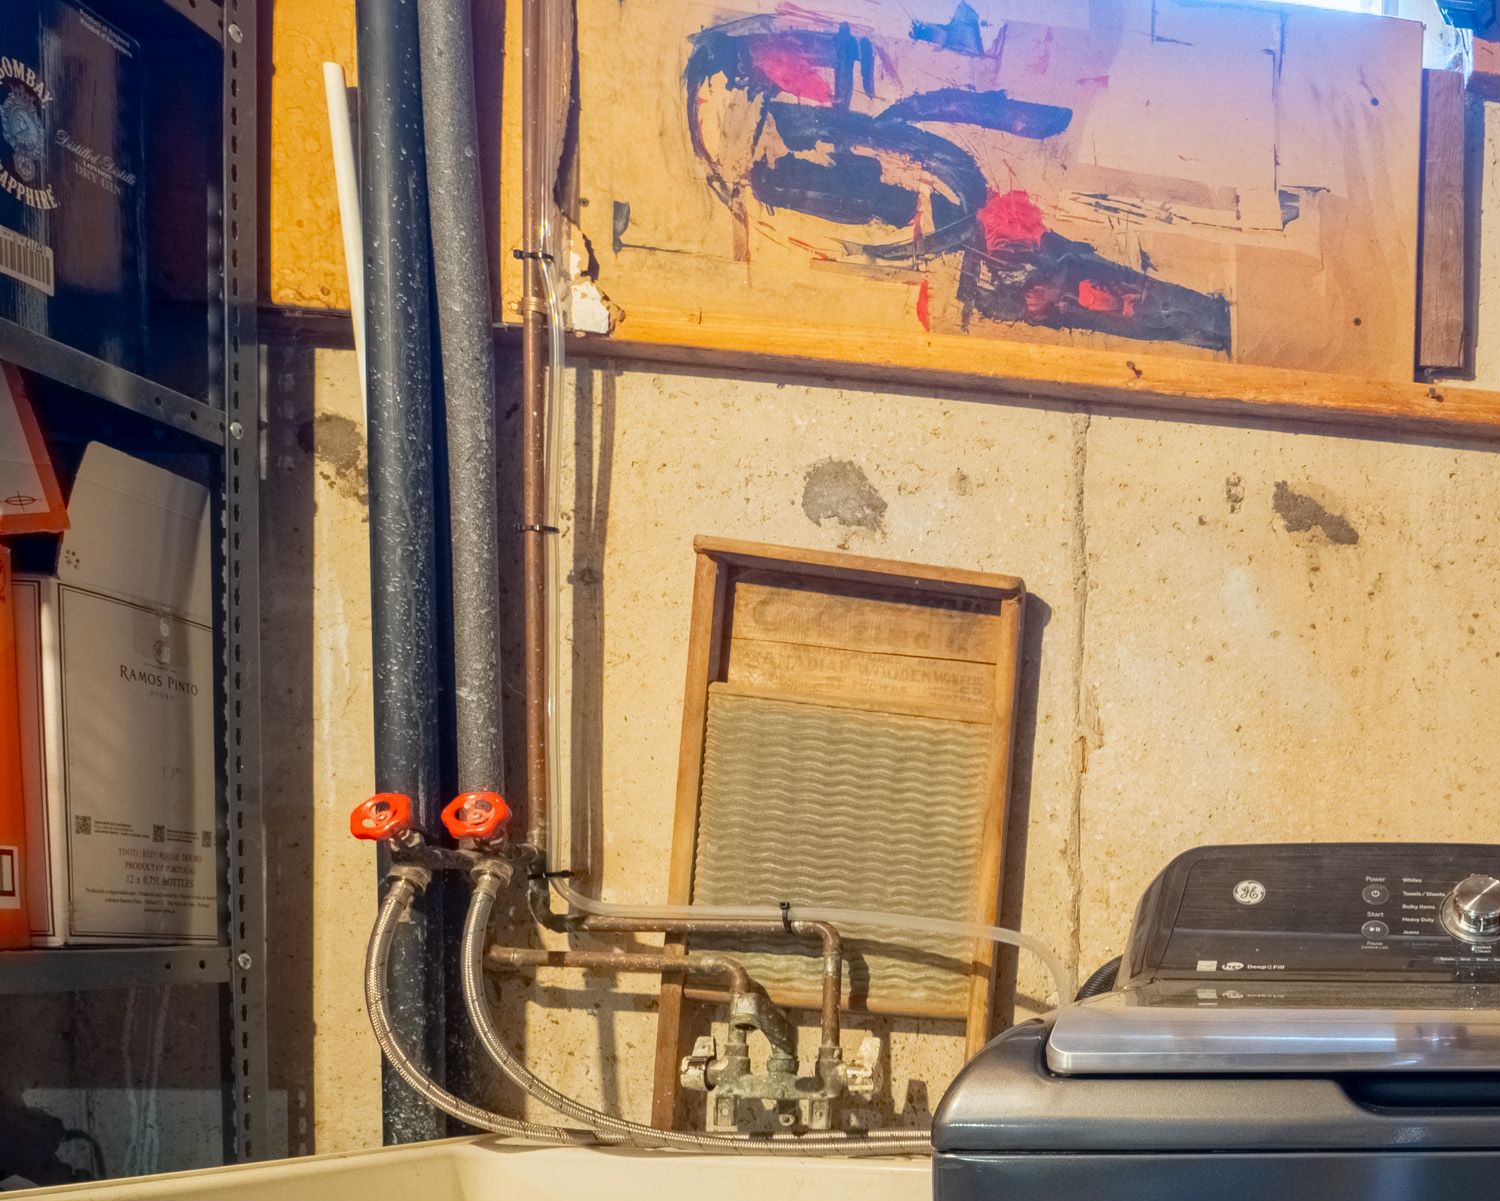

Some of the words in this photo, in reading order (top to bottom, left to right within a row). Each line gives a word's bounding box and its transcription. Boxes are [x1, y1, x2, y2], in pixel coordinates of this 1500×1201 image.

[74, 162, 98, 184] DRY
[0, 164, 58, 210] APPHIRE
[119, 664, 163, 687] RAMOS
[167, 676, 199, 697] PINTO
[119, 848, 139, 856] TINTO
[125, 861, 156, 871] PRODUCT
[126, 874, 134, 884] 12
[162, 877, 194, 888] BOTTLES
